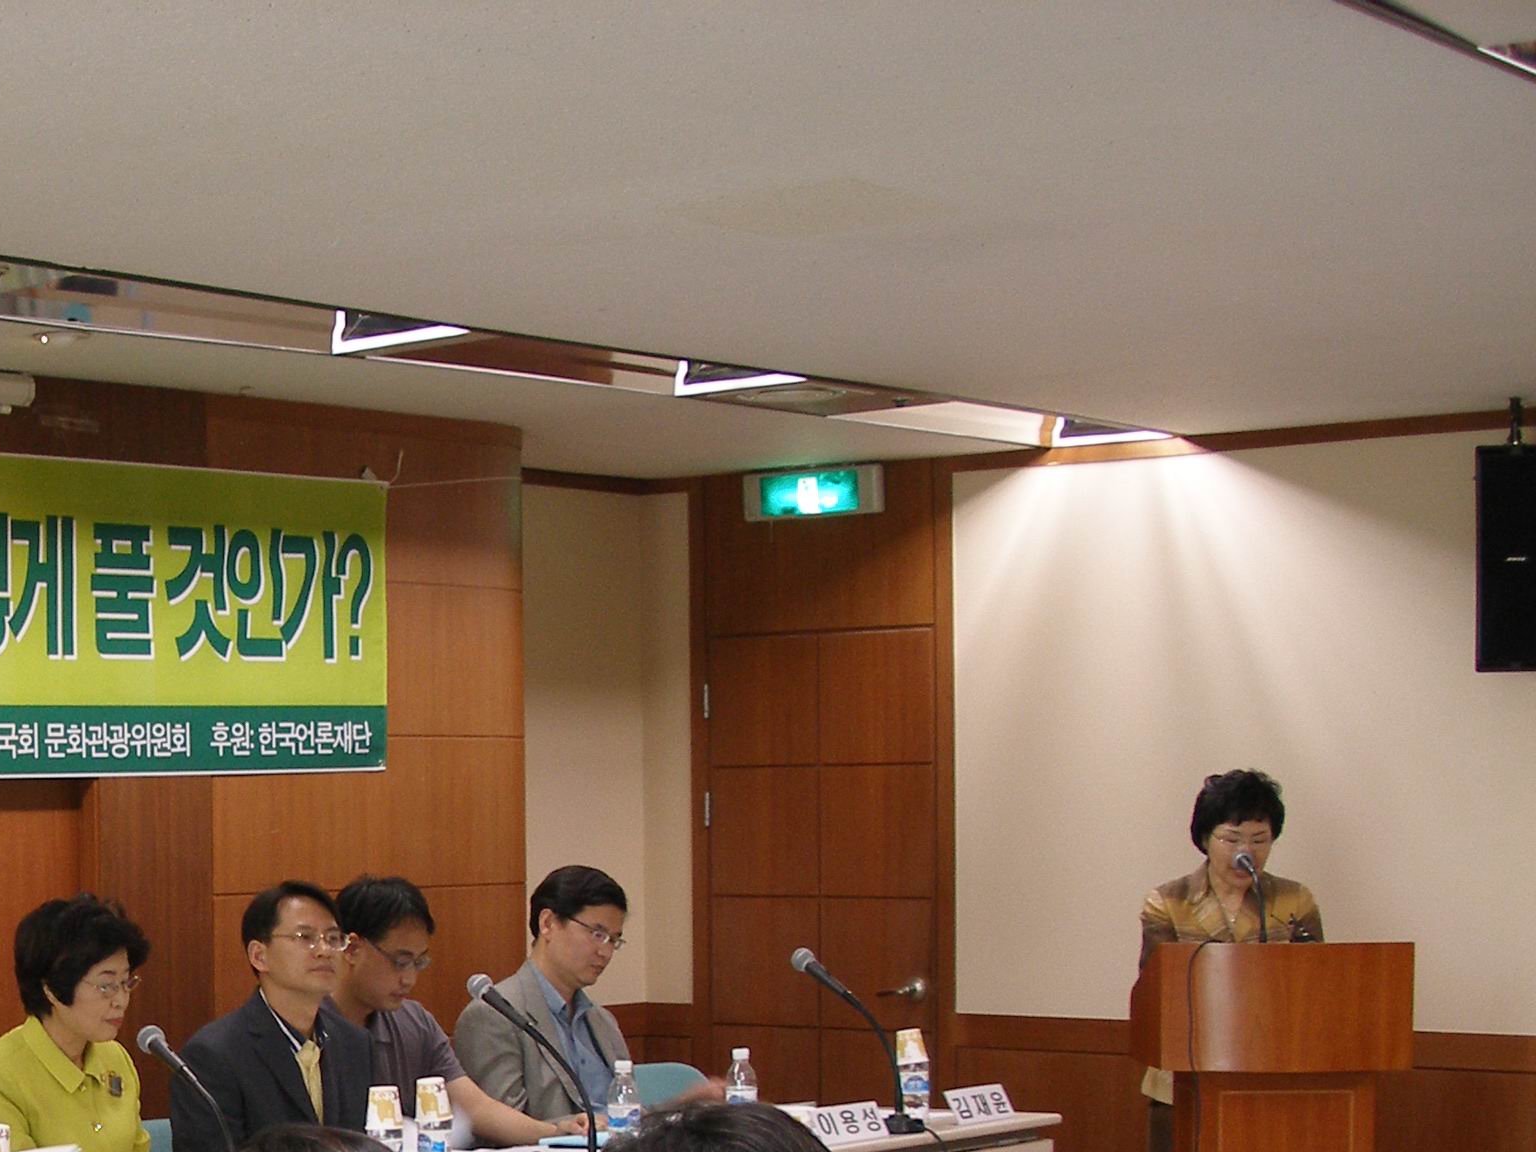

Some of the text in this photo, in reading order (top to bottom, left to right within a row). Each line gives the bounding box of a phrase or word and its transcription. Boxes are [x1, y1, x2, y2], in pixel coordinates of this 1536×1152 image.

[90, 522, 155, 660] 풀
[165, 524, 373, 662] 것인가?
[44, 722, 191, 759] 문화관광위원회
[210, 721, 255, 757] 후원:
[258, 721, 372, 757] 한국언론재단
